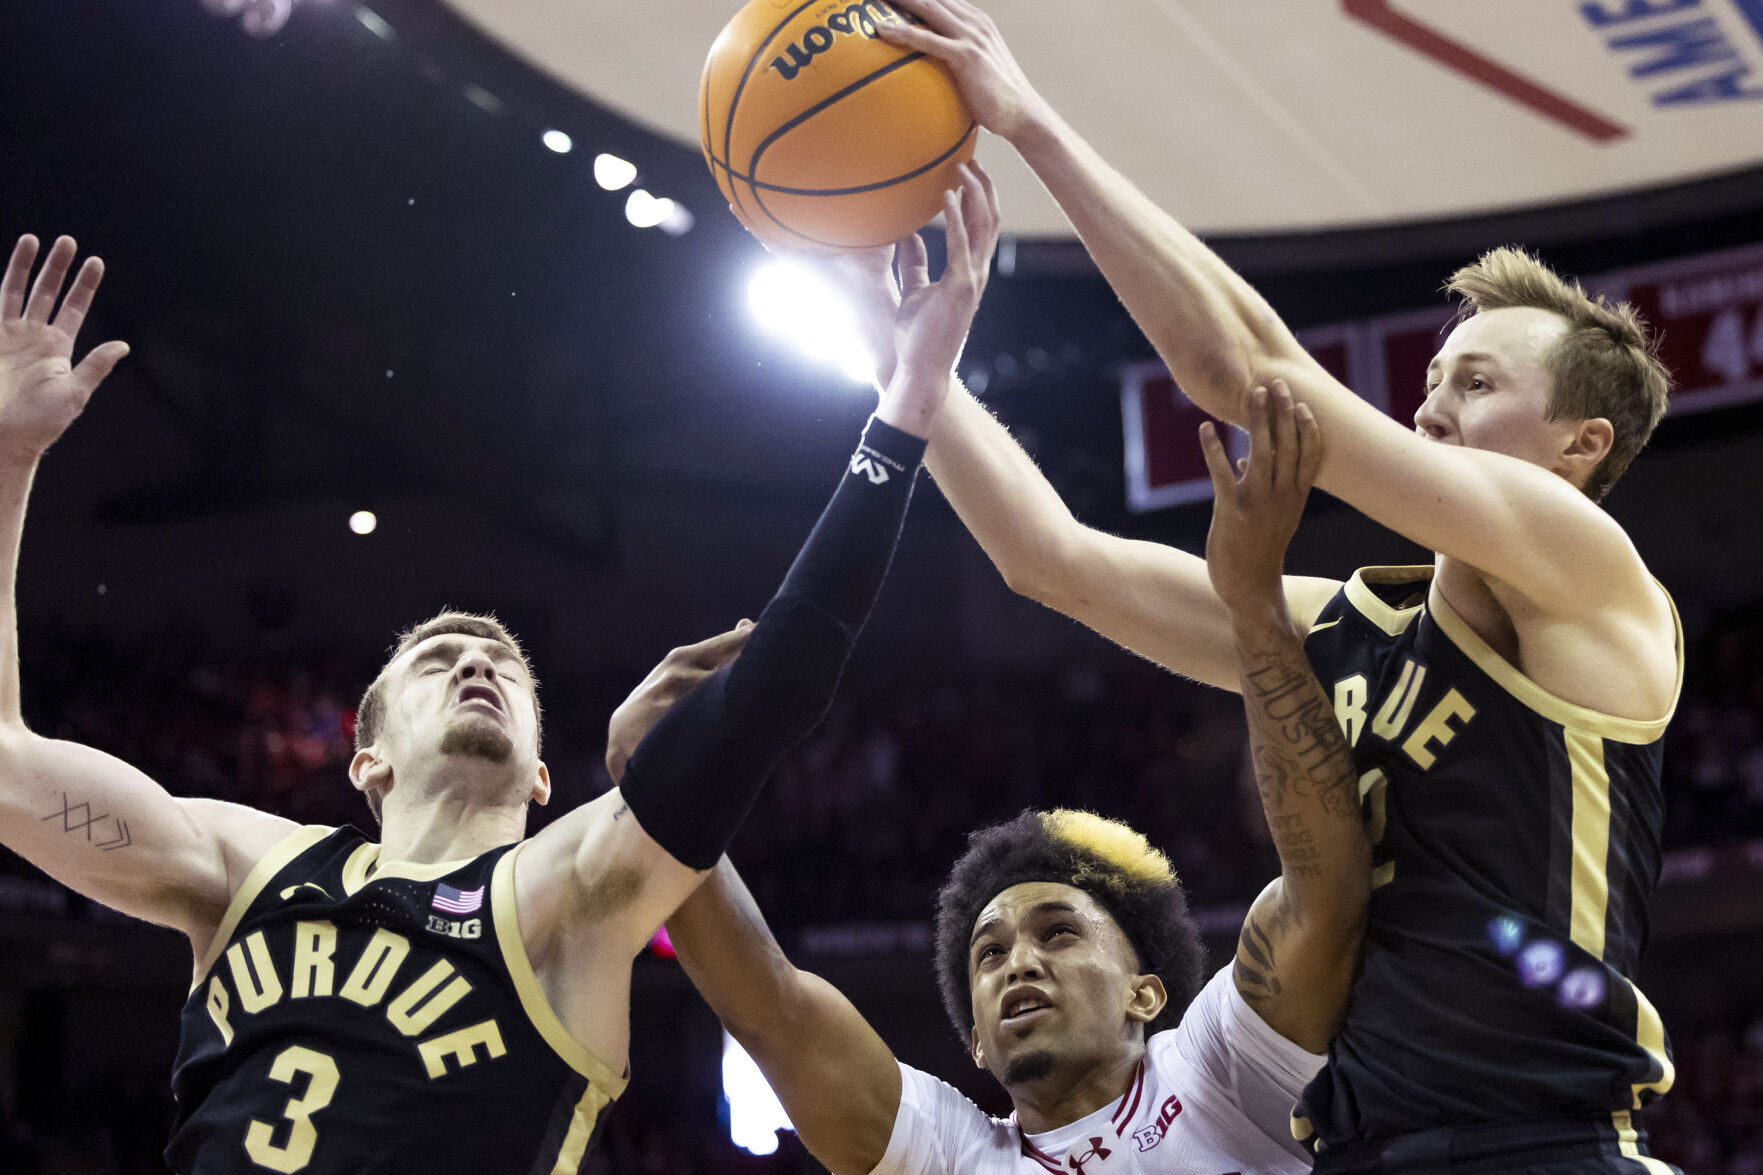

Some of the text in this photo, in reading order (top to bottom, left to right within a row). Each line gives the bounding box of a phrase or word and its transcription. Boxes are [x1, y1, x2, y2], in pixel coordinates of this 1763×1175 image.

[769, 0, 893, 81] ilson
[206, 920, 508, 1080] PURDUE
[244, 1045, 341, 1175] 3
